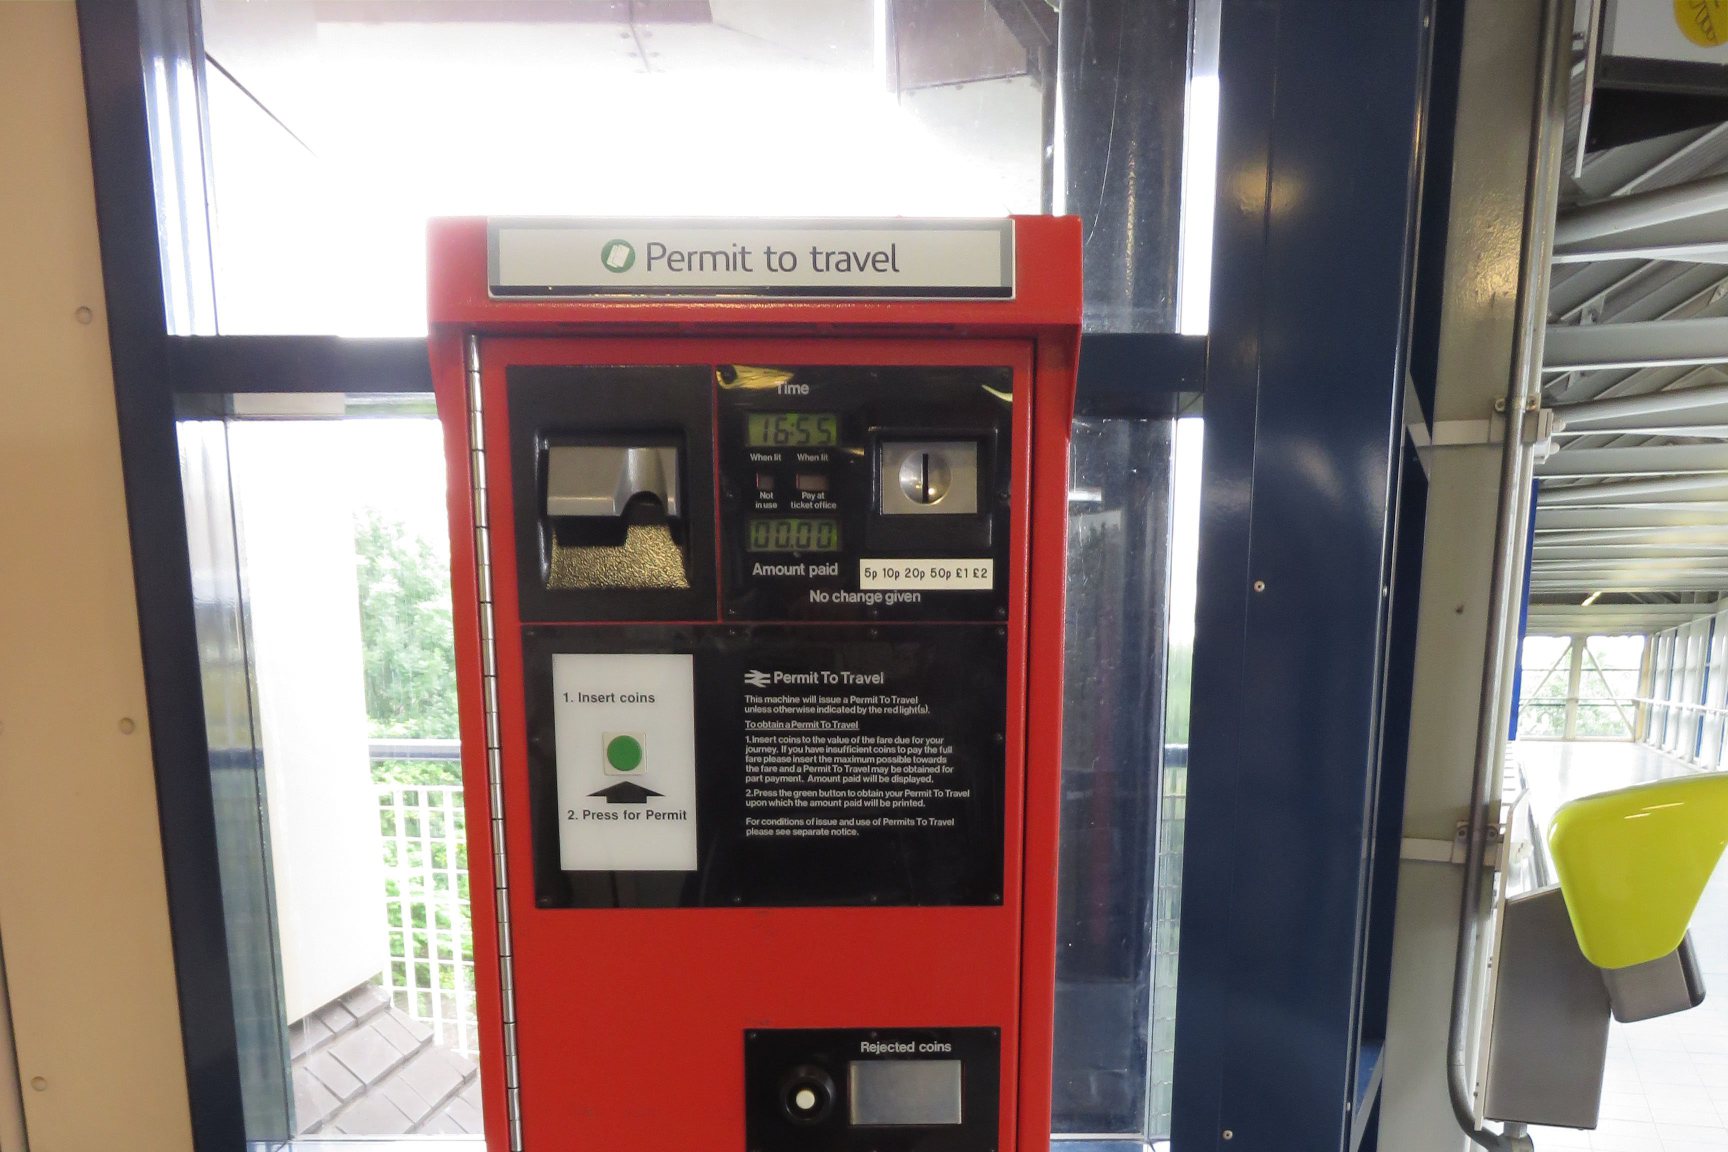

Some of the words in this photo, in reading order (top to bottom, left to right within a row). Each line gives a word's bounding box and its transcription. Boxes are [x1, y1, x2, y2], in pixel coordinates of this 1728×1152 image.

[646, 242, 753, 272] Permit
[763, 246, 797, 272] to
[809, 243, 900, 272] travel
[778, 382, 810, 395] Time
[763, 417, 832, 444] 16:55
[750, 453, 773, 462] When
[774, 453, 782, 462] lit
[797, 453, 819, 462] When
[802, 492, 815, 501] Pay
[791, 501, 813, 509] ticket
[814, 501, 837, 509] office
[753, 522, 833, 548] 00.00
[752, 562, 805, 576] Amount
[809, 562, 838, 578] paid
[864, 568, 877, 580] 5p
[883, 568, 900, 580] 10p
[905, 568, 925, 580] 20p
[930, 568, 951, 580] 50p
[956, 568, 968, 578] £1
[972, 568, 987, 578] £2
[810, 590, 829, 602] No
[832, 590, 882, 604] change
[885, 589, 921, 605] given
[774, 672, 818, 685] Permit
[821, 672, 838, 685] To
[841, 672, 884, 685] Travel
[563, 692, 574, 703] 1.
[578, 692, 615, 703] Insert
[620, 692, 655, 703] coins
[745, 695, 762, 704] This
[764, 695, 800, 704] machine
[803, 695, 816, 704] will
[819, 695, 841, 704] issue
[850, 695, 878, 704] Permit
[879, 695, 890, 704] To
[891, 695, 918, 704] Travel
[744, 706, 772, 714] unless
[773, 706, 815, 714] otherwise
[817, 706, 855, 714] indicated
[857, 706, 866, 715] by
[869, 706, 882, 714] the
[884, 706, 898, 714] red
[900, 704, 930, 716] light(s).
[745, 721, 756, 729] To
[757, 721, 784, 729] obtain
[792, 721, 819, 729] Permit
[821, 721, 831, 729] To
[832, 721, 858, 729] Travel
[778, 736, 801, 744] coins
[802, 736, 810, 744] to
[812, 736, 825, 744] the
[827, 736, 850, 744] value
[851, 736, 860, 744] of
[862, 736, 875, 744] the
[877, 736, 893, 744] fare
[895, 736, 910, 744] due
[912, 736, 924, 744] for
[745, 746, 779, 754] journey.
[781, 746, 787, 754] If
[805, 746, 824, 754] have
[826, 746, 872, 754] insufficient
[873, 746, 896, 754] coins
[897, 746, 906, 754] to
[924, 746, 937, 754] the
[939, 746, 952, 754] full
[745, 755, 762, 763] fare
[763, 755, 791, 764] please
[793, 755, 817, 763] insert
[819, 755, 832, 763] the
[834, 755, 875, 763] maximum
[876, 755, 910, 764] possible
[913, 755, 947, 763] towards
[745, 765, 759, 773] the
[761, 765, 778, 773] fare
[779, 765, 795, 773] and
[803, 765, 831, 773] Permit
[832, 765, 842, 773] To
[844, 765, 870, 773] Travel
[891, 765, 900, 773] be
[903, 765, 940, 773] obtained
[942, 765, 954, 773] for
[765, 776, 804, 784] payment.
[807, 775, 840, 783] Amount
[843, 775, 860, 784] paid
[863, 775, 877, 783] will
[879, 775, 890, 783] be
[891, 775, 934, 784] displayed.
[779, 789, 792, 797] the
[793, 790, 817, 798] green
[819, 789, 846, 797] button
[848, 789, 856, 797] to
[857, 789, 883, 797] obtain
[885, 790, 903, 798] your
[905, 789, 932, 797] Permit
[933, 789, 943, 797] To
[945, 789, 970, 797] Travel
[768, 799, 793, 807] which
[795, 799, 808, 807] the
[810, 799, 842, 807] amount
[844, 799, 862, 808] paid
[864, 799, 878, 807] will
[880, 799, 890, 807] be
[892, 799, 926, 808] printed.
[568, 810, 578, 820] 2.
[583, 810, 618, 820] Press
[623, 810, 641, 820] for
[646, 810, 687, 820] Permit
[746, 818, 760, 826] For
[761, 818, 804, 826] conditions
[806, 818, 815, 826] of
[816, 818, 837, 826] issue
[839, 818, 854, 826] and
[872, 818, 881, 826] of
[883, 818, 915, 826] Permits
[916, 818, 928, 826] To
[930, 818, 955, 826] Travel
[746, 828, 774, 837] please
[793, 828, 829, 837] separate
[831, 828, 859, 836] notice.
[860, 1041, 915, 1055] Rejected
[919, 1041, 952, 1052] coins
